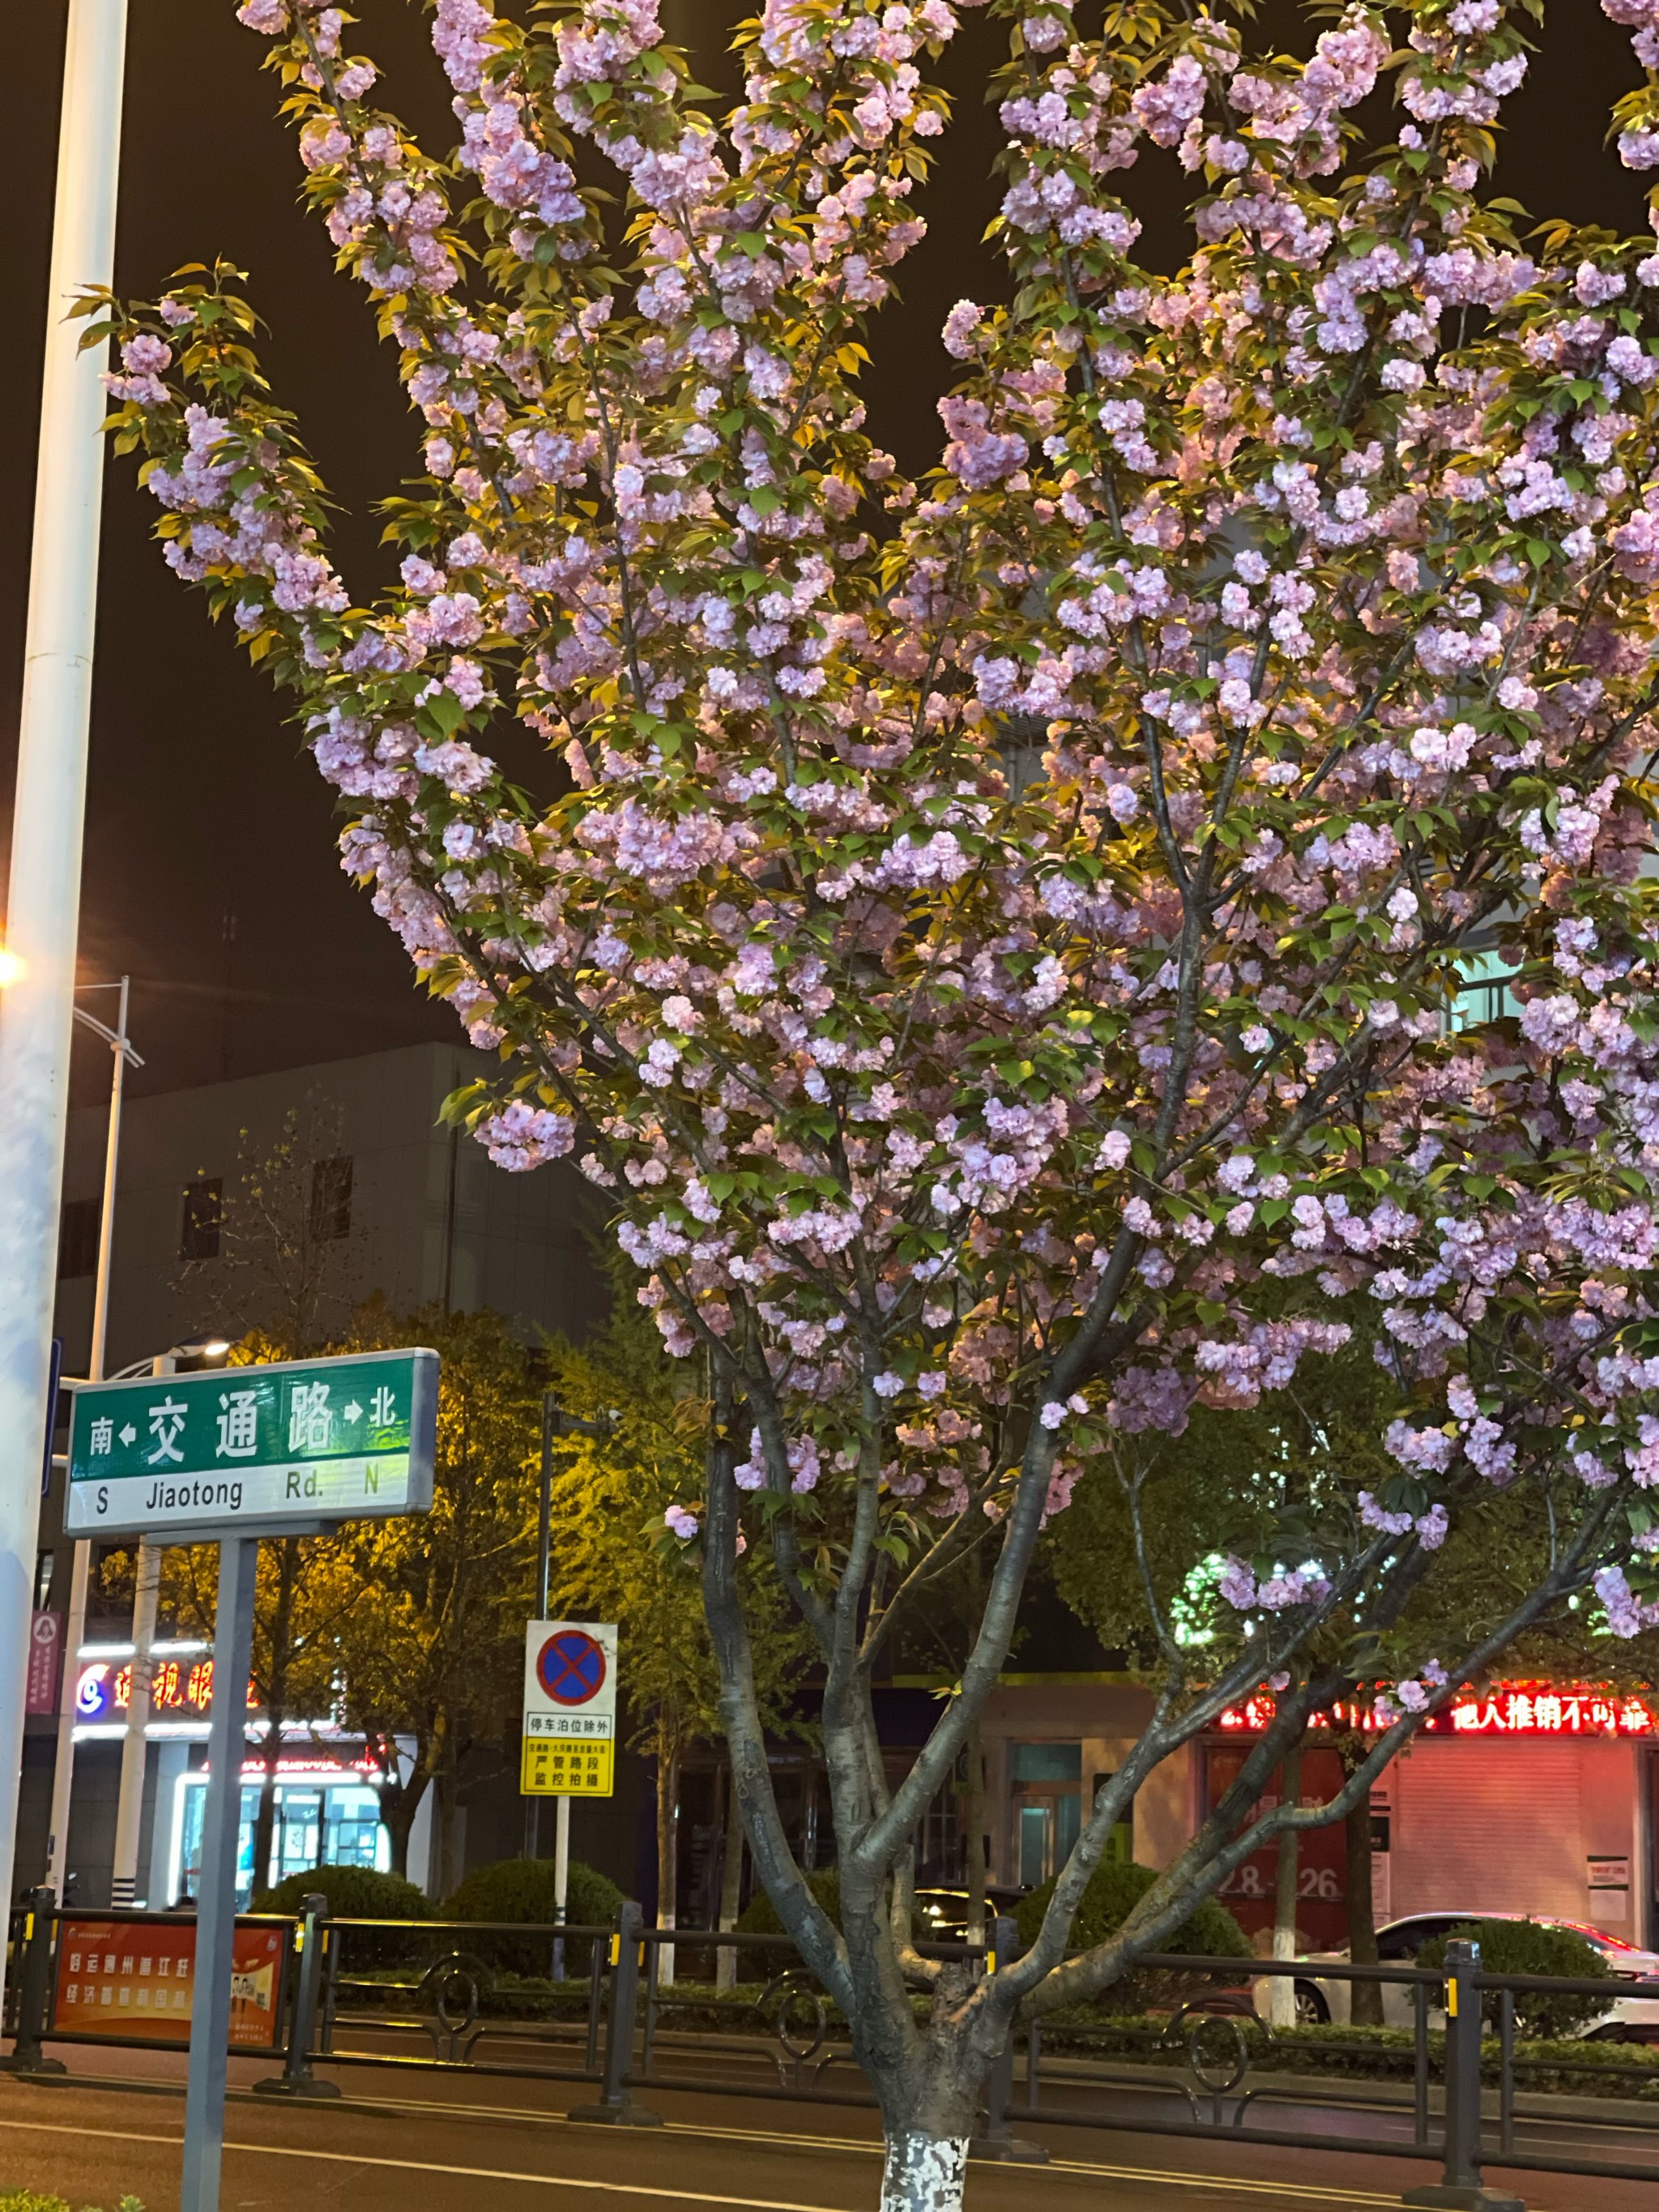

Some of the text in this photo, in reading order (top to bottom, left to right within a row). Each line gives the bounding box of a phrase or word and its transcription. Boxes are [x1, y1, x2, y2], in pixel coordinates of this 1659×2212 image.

[90, 1381, 396, 1466] 南 交通路 北
[96, 1463, 379, 1515] S Jiaotong Rd. N
[531, 1717, 608, 1734] 停车泊位除外
[535, 1755, 599, 1770] 严管路段
[535, 1771, 598, 1787] 监控拍摄
